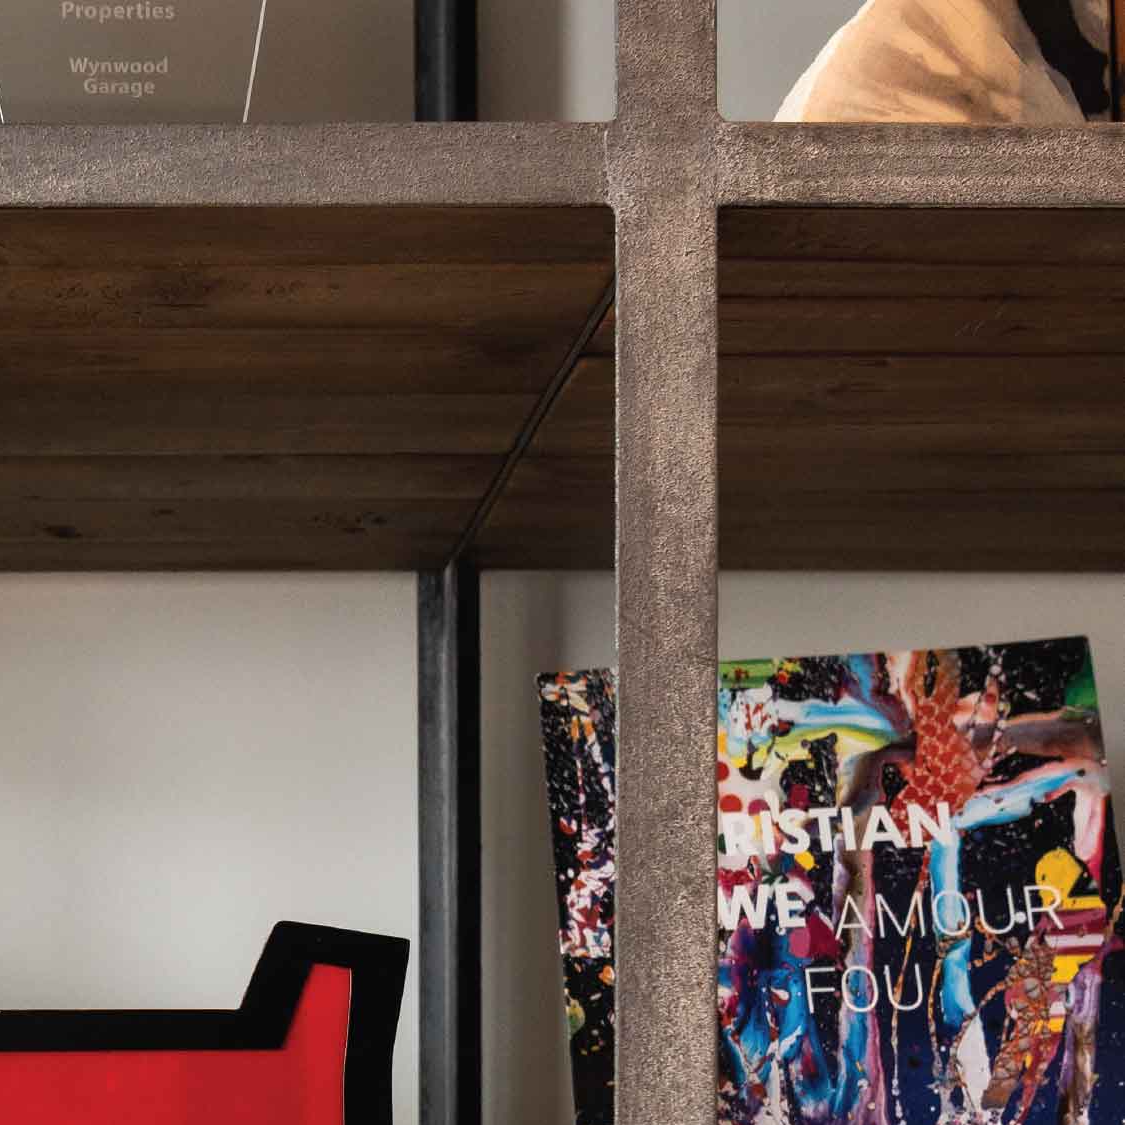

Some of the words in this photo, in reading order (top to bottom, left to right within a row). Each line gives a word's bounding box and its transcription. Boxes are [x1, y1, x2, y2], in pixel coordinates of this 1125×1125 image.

[61, 1, 175, 24] Properties
[69, 57, 168, 77] Wynwood
[83, 79, 155, 97] Garage
[835, 885, 1064, 940] AMOUR
[805, 963, 923, 1014] FOU
